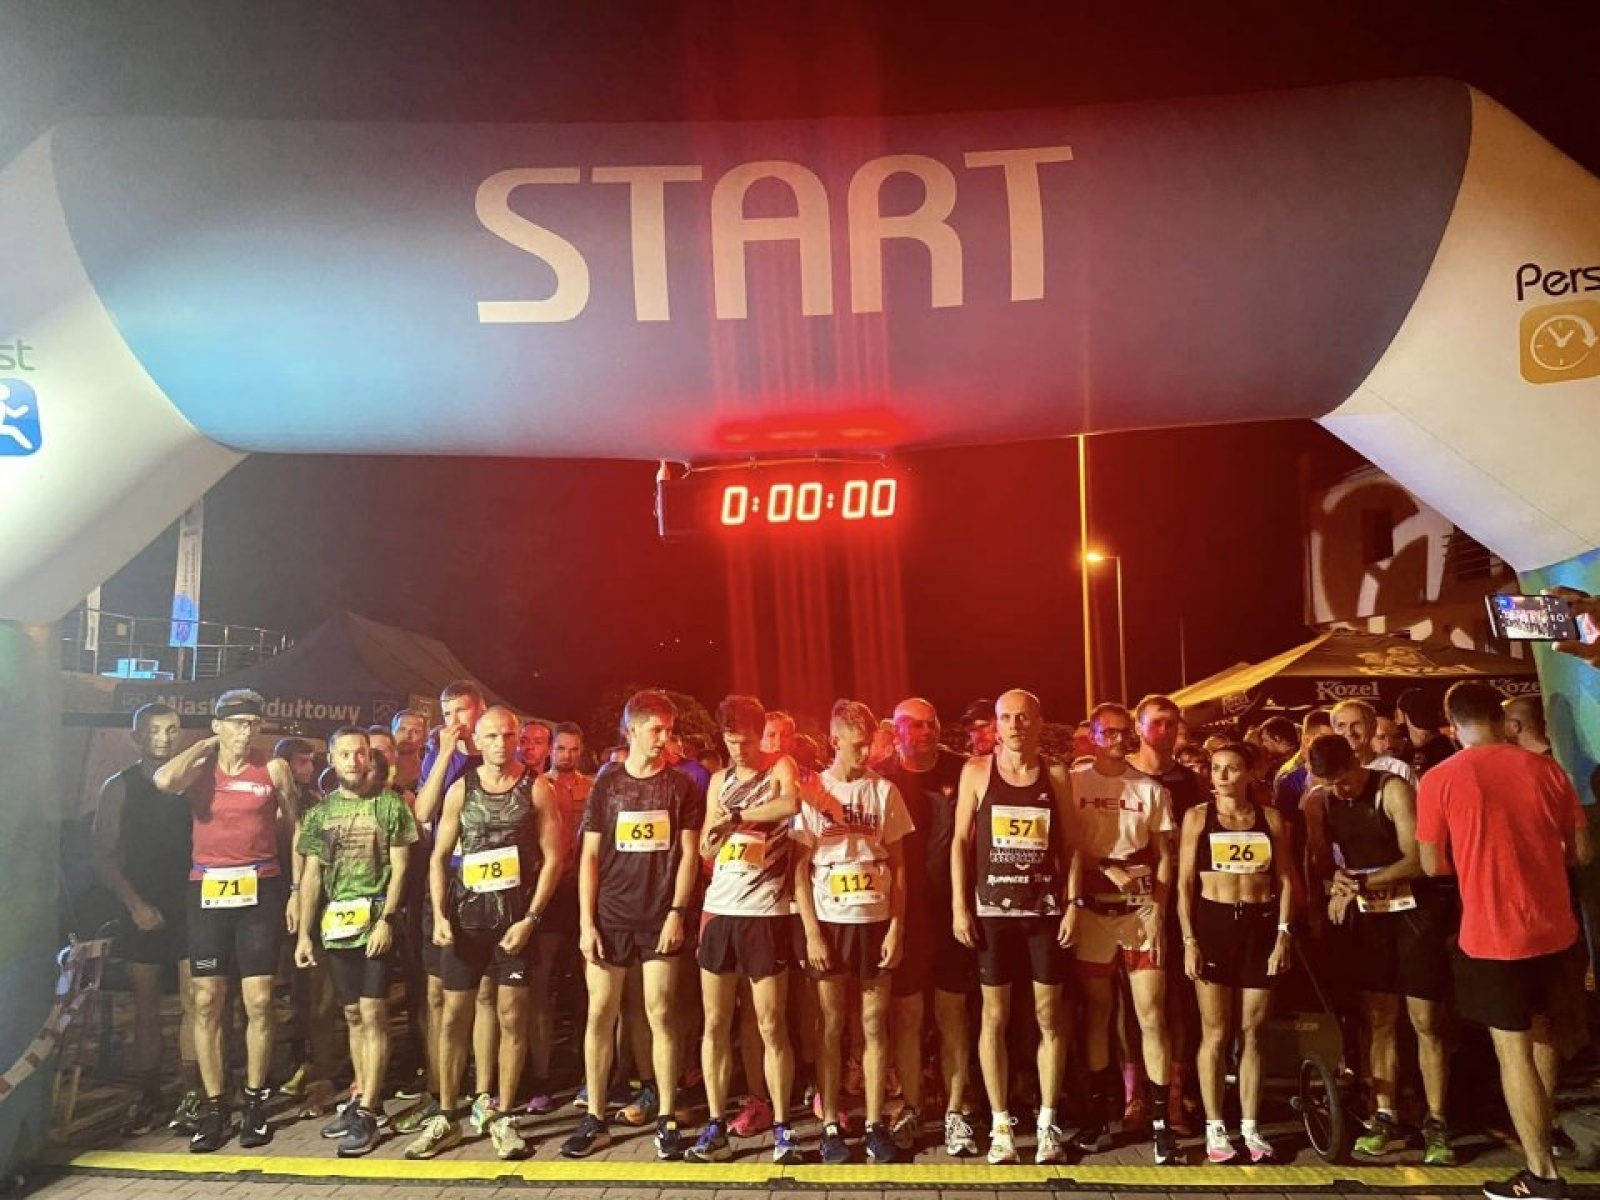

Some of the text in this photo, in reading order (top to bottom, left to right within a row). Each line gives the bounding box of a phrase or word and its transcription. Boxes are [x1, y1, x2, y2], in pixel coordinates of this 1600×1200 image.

[474, 146, 1074, 323] START
[721, 479, 897, 526] 0:00:00
[1315, 680, 1381, 701] Kozel
[1489, 678, 1541, 698] Koze
[261, 697, 361, 725] dułtowy
[631, 823, 654, 840] 63
[1009, 819, 1033, 837] 57
[728, 843, 747, 861] 27
[1229, 844, 1254, 861] 26
[480, 862, 503, 878] 78
[218, 880, 240, 896] 71
[840, 873, 874, 892] 112
